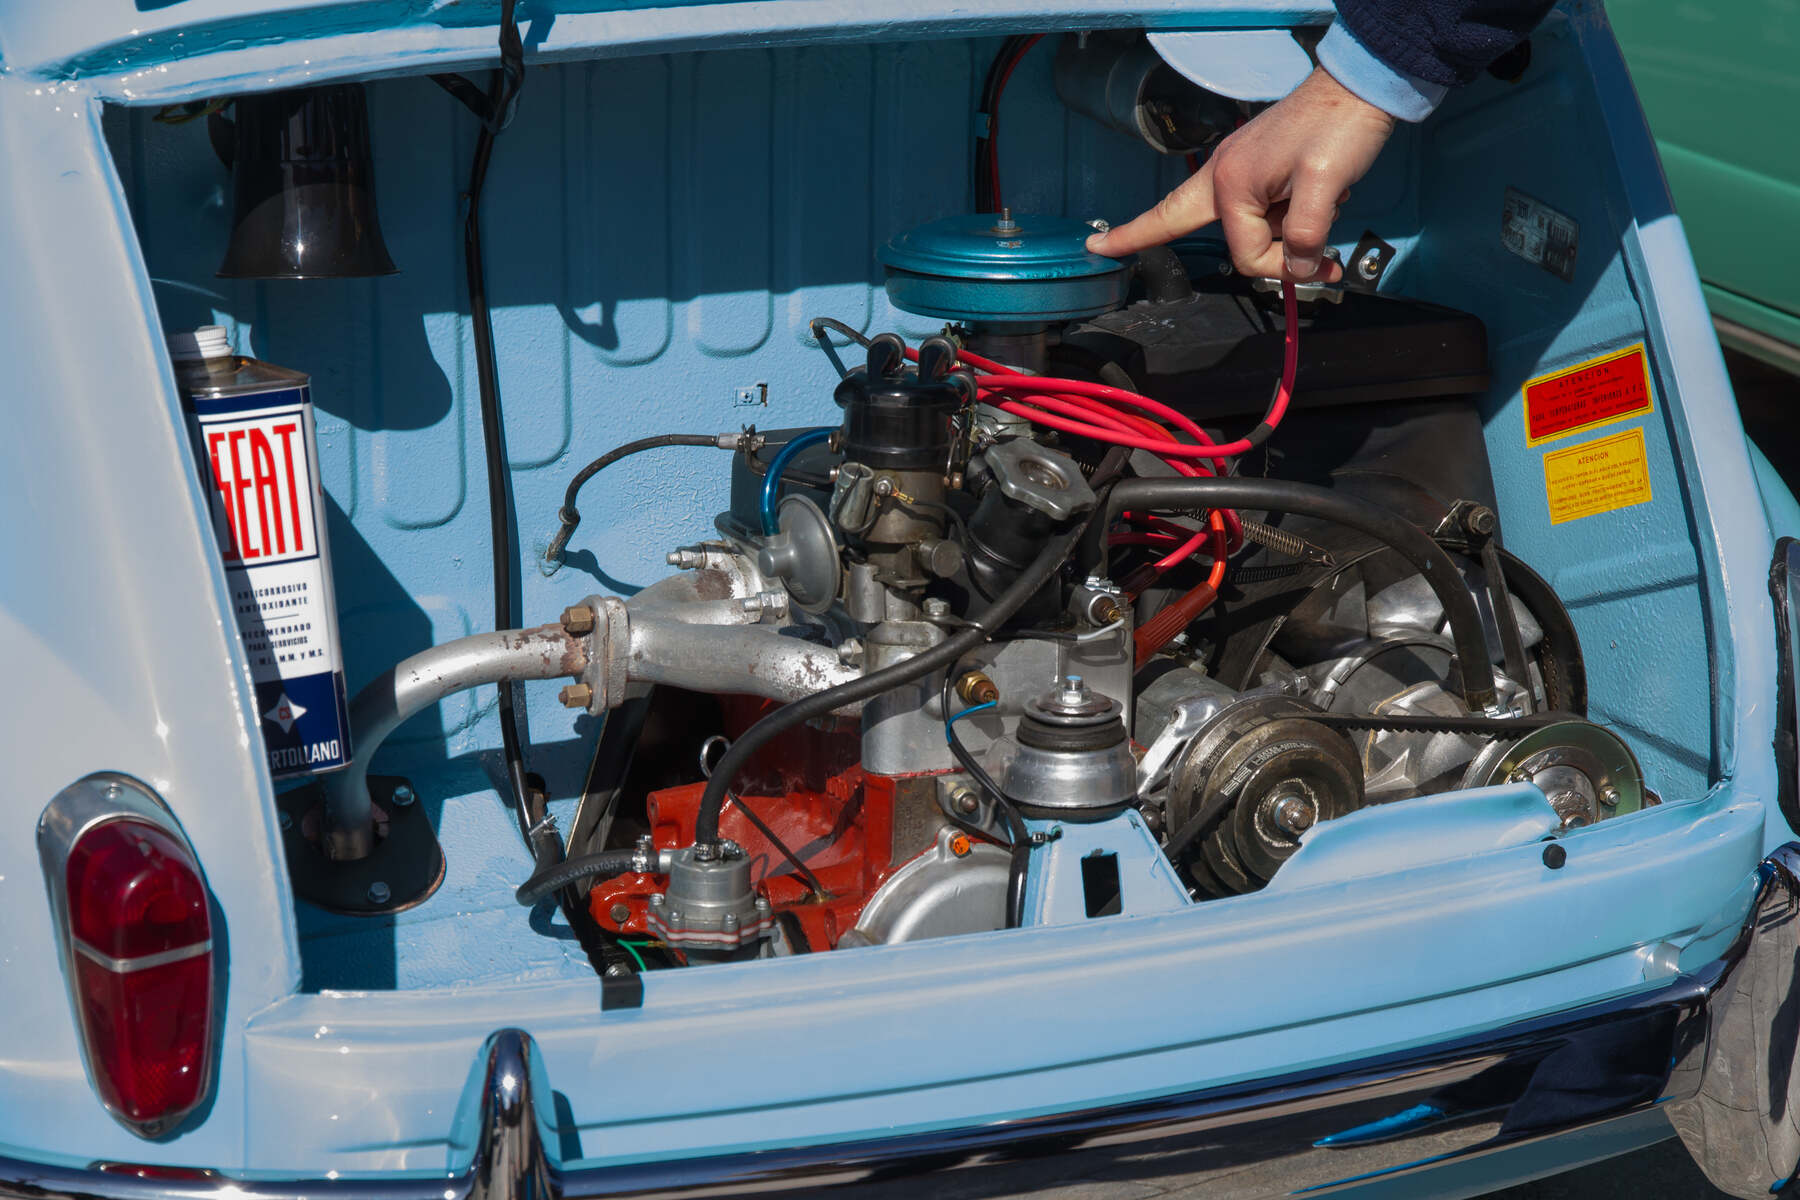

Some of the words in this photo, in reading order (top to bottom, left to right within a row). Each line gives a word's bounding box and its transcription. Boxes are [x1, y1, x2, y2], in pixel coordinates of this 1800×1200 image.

[1578, 451, 1609, 465] ATENCION
[208, 423, 304, 561] SEAT
[237, 582, 308, 600] ANTICORROSIVO
[238, 597, 308, 614] ANTIOXIDANTE
[242, 622, 312, 640] RECOMENDADO
[268, 739, 340, 768] RTOLLANO
